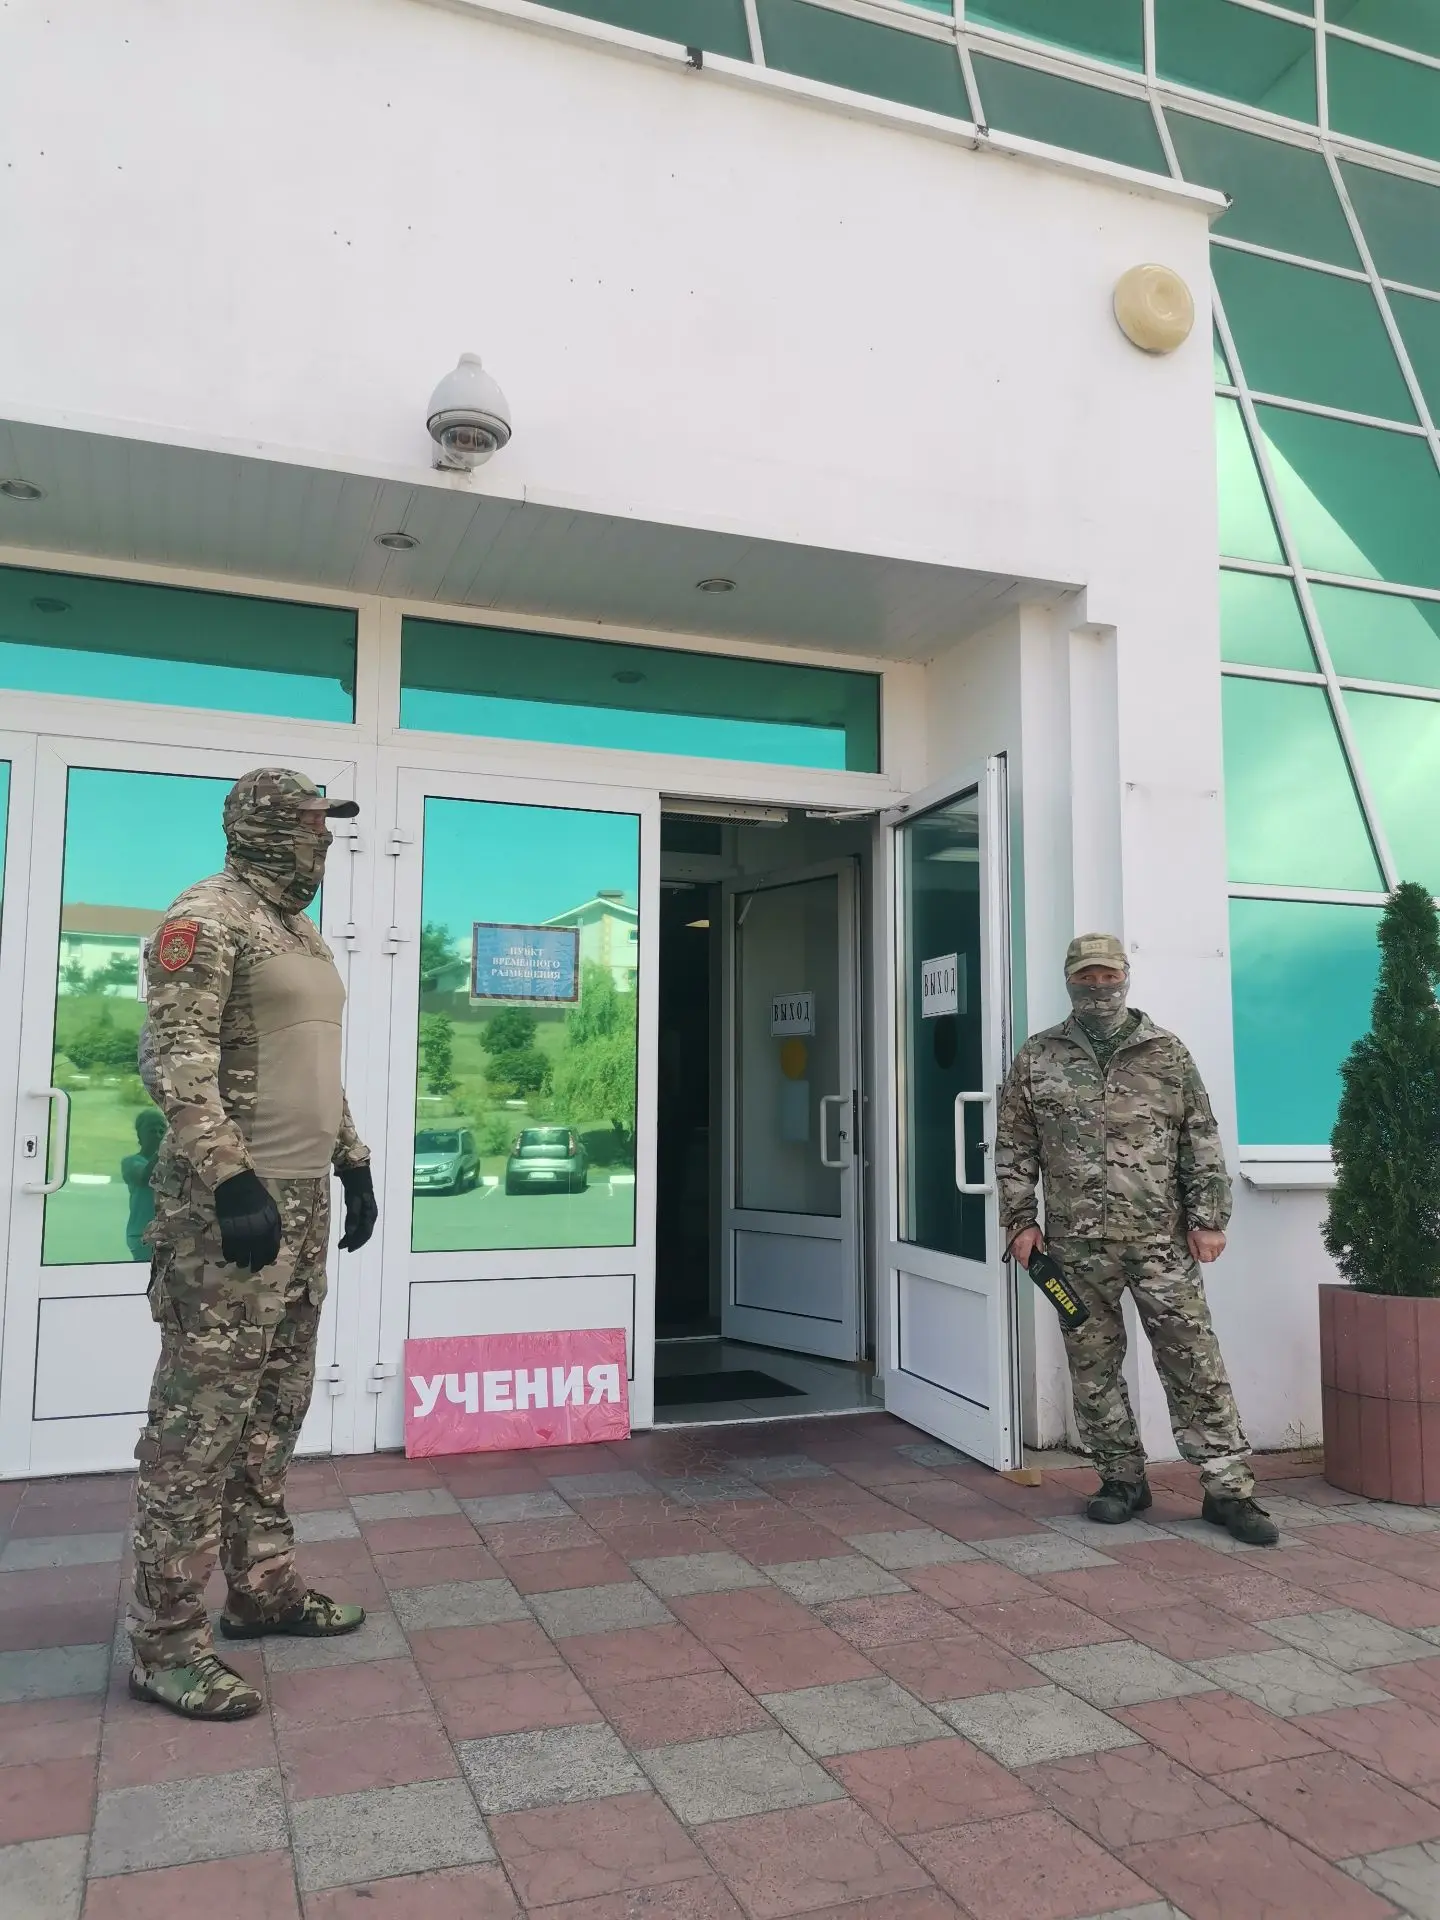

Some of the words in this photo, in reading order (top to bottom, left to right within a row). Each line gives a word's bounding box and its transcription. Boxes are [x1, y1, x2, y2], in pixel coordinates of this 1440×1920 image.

[510, 946, 545, 957] ПУНКТ
[492, 957, 561, 969] ВРЕМЕННОГО
[491, 969, 561, 980] РАЗМЕЩЕНИЯ
[924, 967, 956, 997] ВЫХОД
[773, 1001, 810, 1022] ВЫХОД
[1045, 1277, 1078, 1315] SPHINX
[409, 1363, 621, 1418] УЧЕНИЯ
